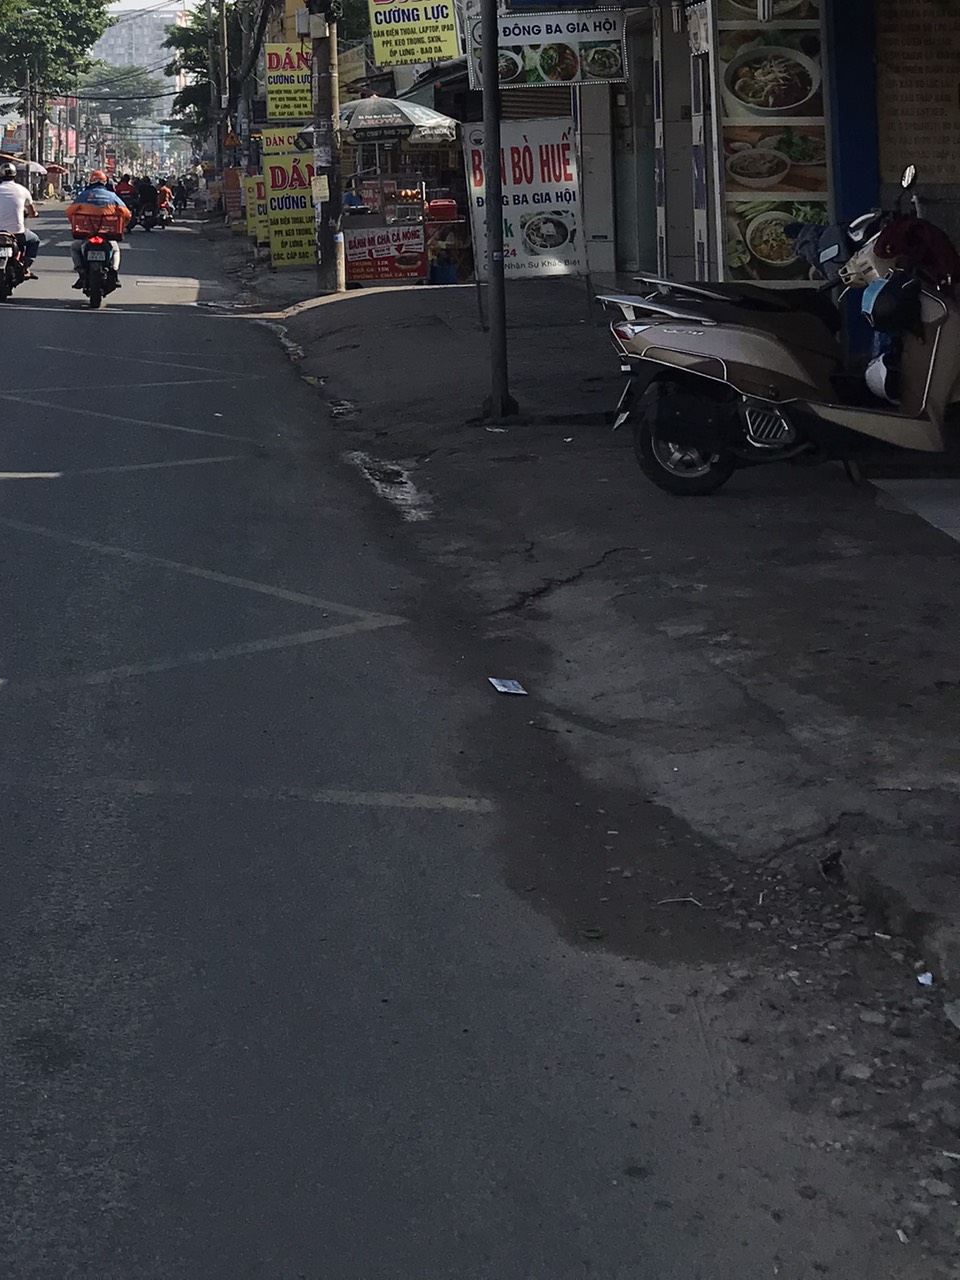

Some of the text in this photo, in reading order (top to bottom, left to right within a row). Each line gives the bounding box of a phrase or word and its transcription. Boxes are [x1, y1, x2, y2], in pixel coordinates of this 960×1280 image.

[374, 4, 449, 25] CƯỜNG LỰC
[502, 19, 617, 37] ĐÔNG BA GIA HỘI
[267, 47, 312, 71] DÁN
[267, 74, 295, 85] CƯỜNG
[265, 133, 285, 147] DÁN
[510, 135, 534, 185] BÒ
[539, 127, 573, 183] HUẾ
[269, 192, 307, 211] CƯỜNG
[512, 194, 529, 206] BA
[532, 192, 552, 204] GIA
[555, 188, 577, 203] HỘI
